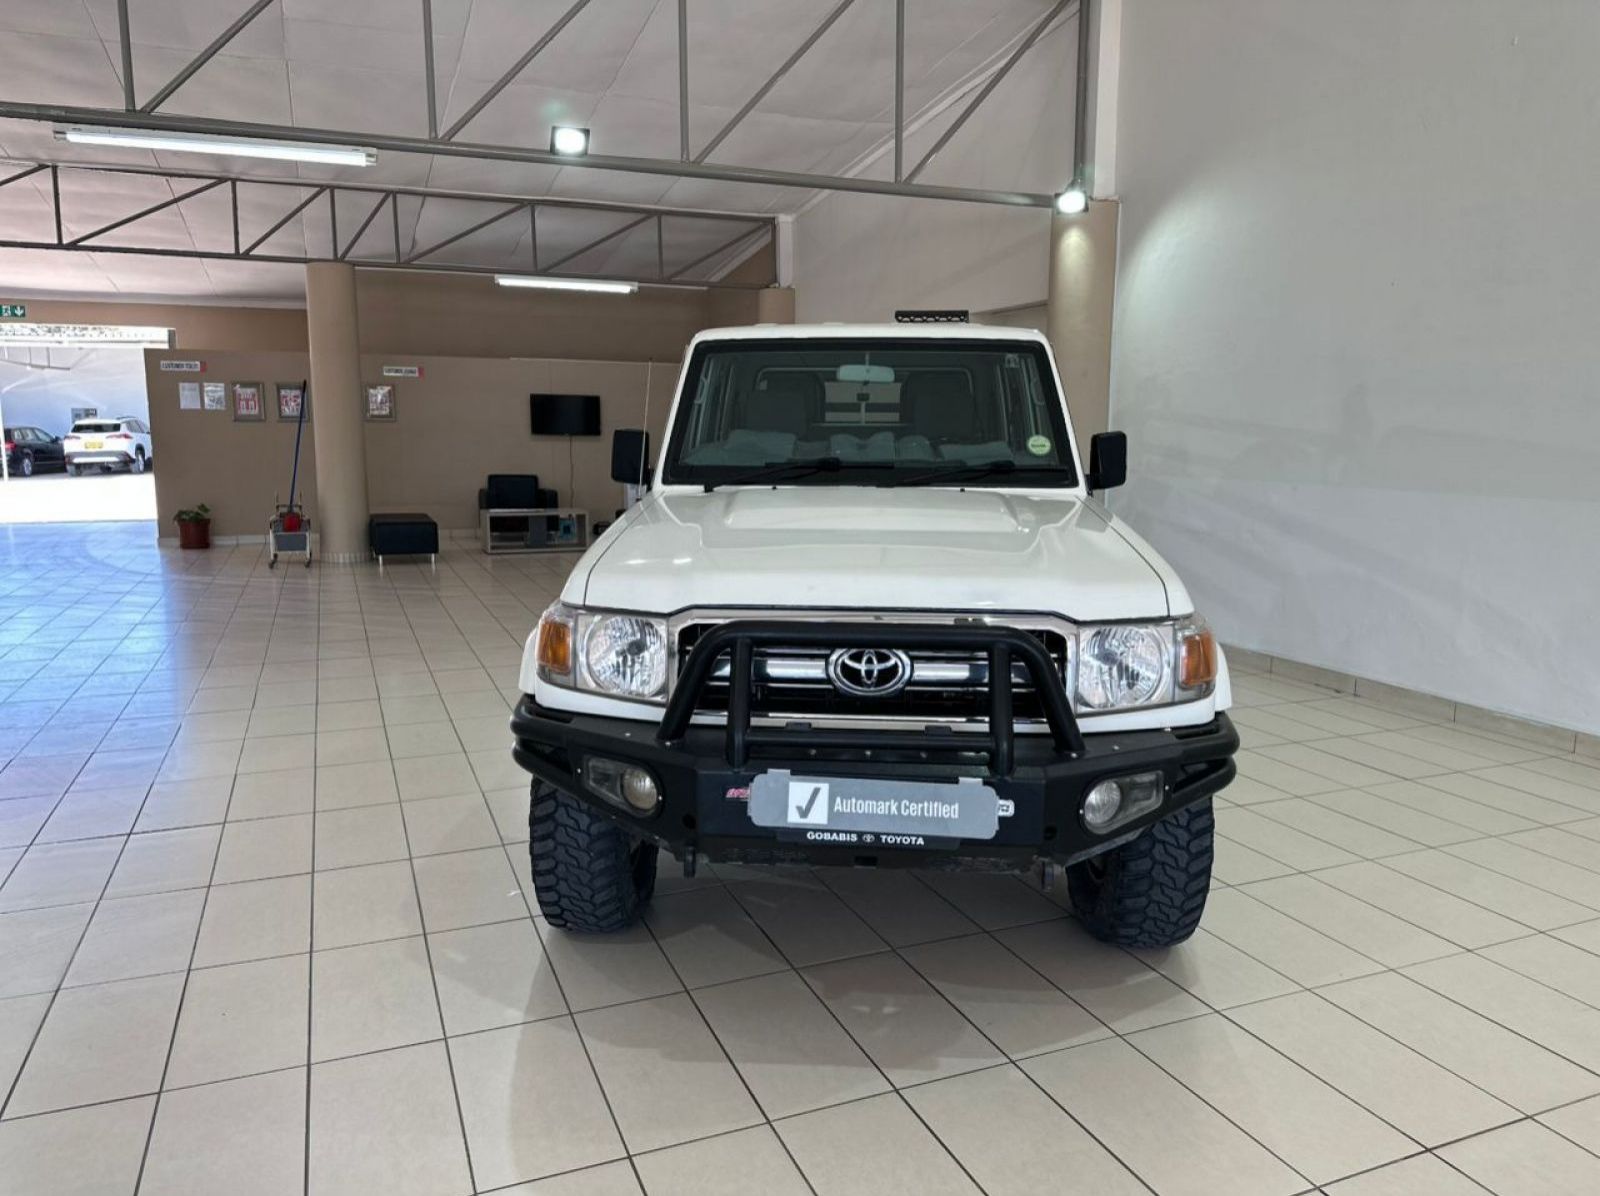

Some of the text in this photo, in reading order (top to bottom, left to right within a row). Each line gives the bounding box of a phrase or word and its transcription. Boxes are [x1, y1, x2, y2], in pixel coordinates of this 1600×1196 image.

[833, 795, 960, 819] Automark Certified
[806, 831, 925, 846] GOBABIS TOYOTA
